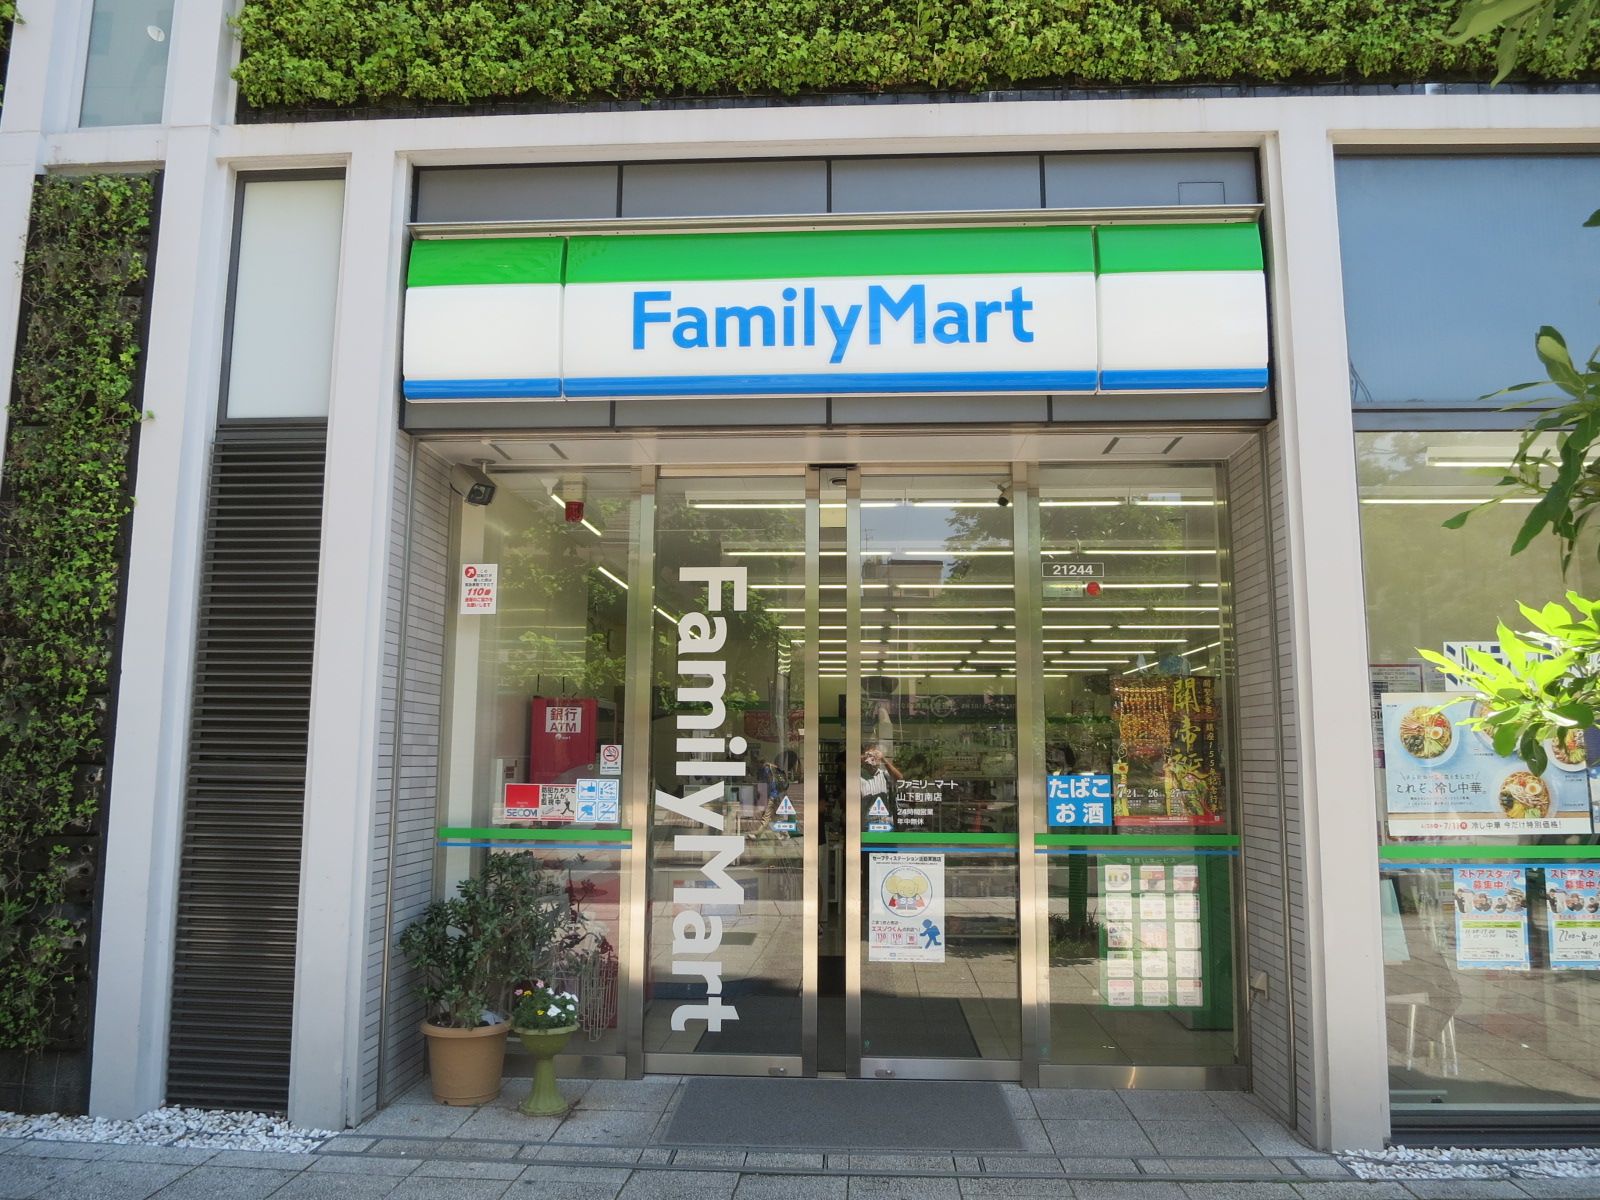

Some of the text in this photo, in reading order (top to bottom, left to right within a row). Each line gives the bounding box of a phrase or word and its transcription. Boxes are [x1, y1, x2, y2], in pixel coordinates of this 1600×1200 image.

[633, 284, 1034, 364] FamilyMart
[1052, 564, 1094, 575] 21244
[550, 707, 578, 721] 銀行
[550, 722, 576, 732] ATM
[896, 779, 959, 790] ファミリーマート
[1049, 778, 1110, 799] たばこ
[655, 566, 747, 1032] FamilyMart
[896, 792, 943, 802] 山下町南店
[506, 808, 538, 817] SECOM
[896, 808, 934, 816] 24時間営業
[1055, 802, 1104, 824] お酒
[896, 818, 925, 826] 年中無休
[1459, 869, 1521, 879] ストアスタッフ
